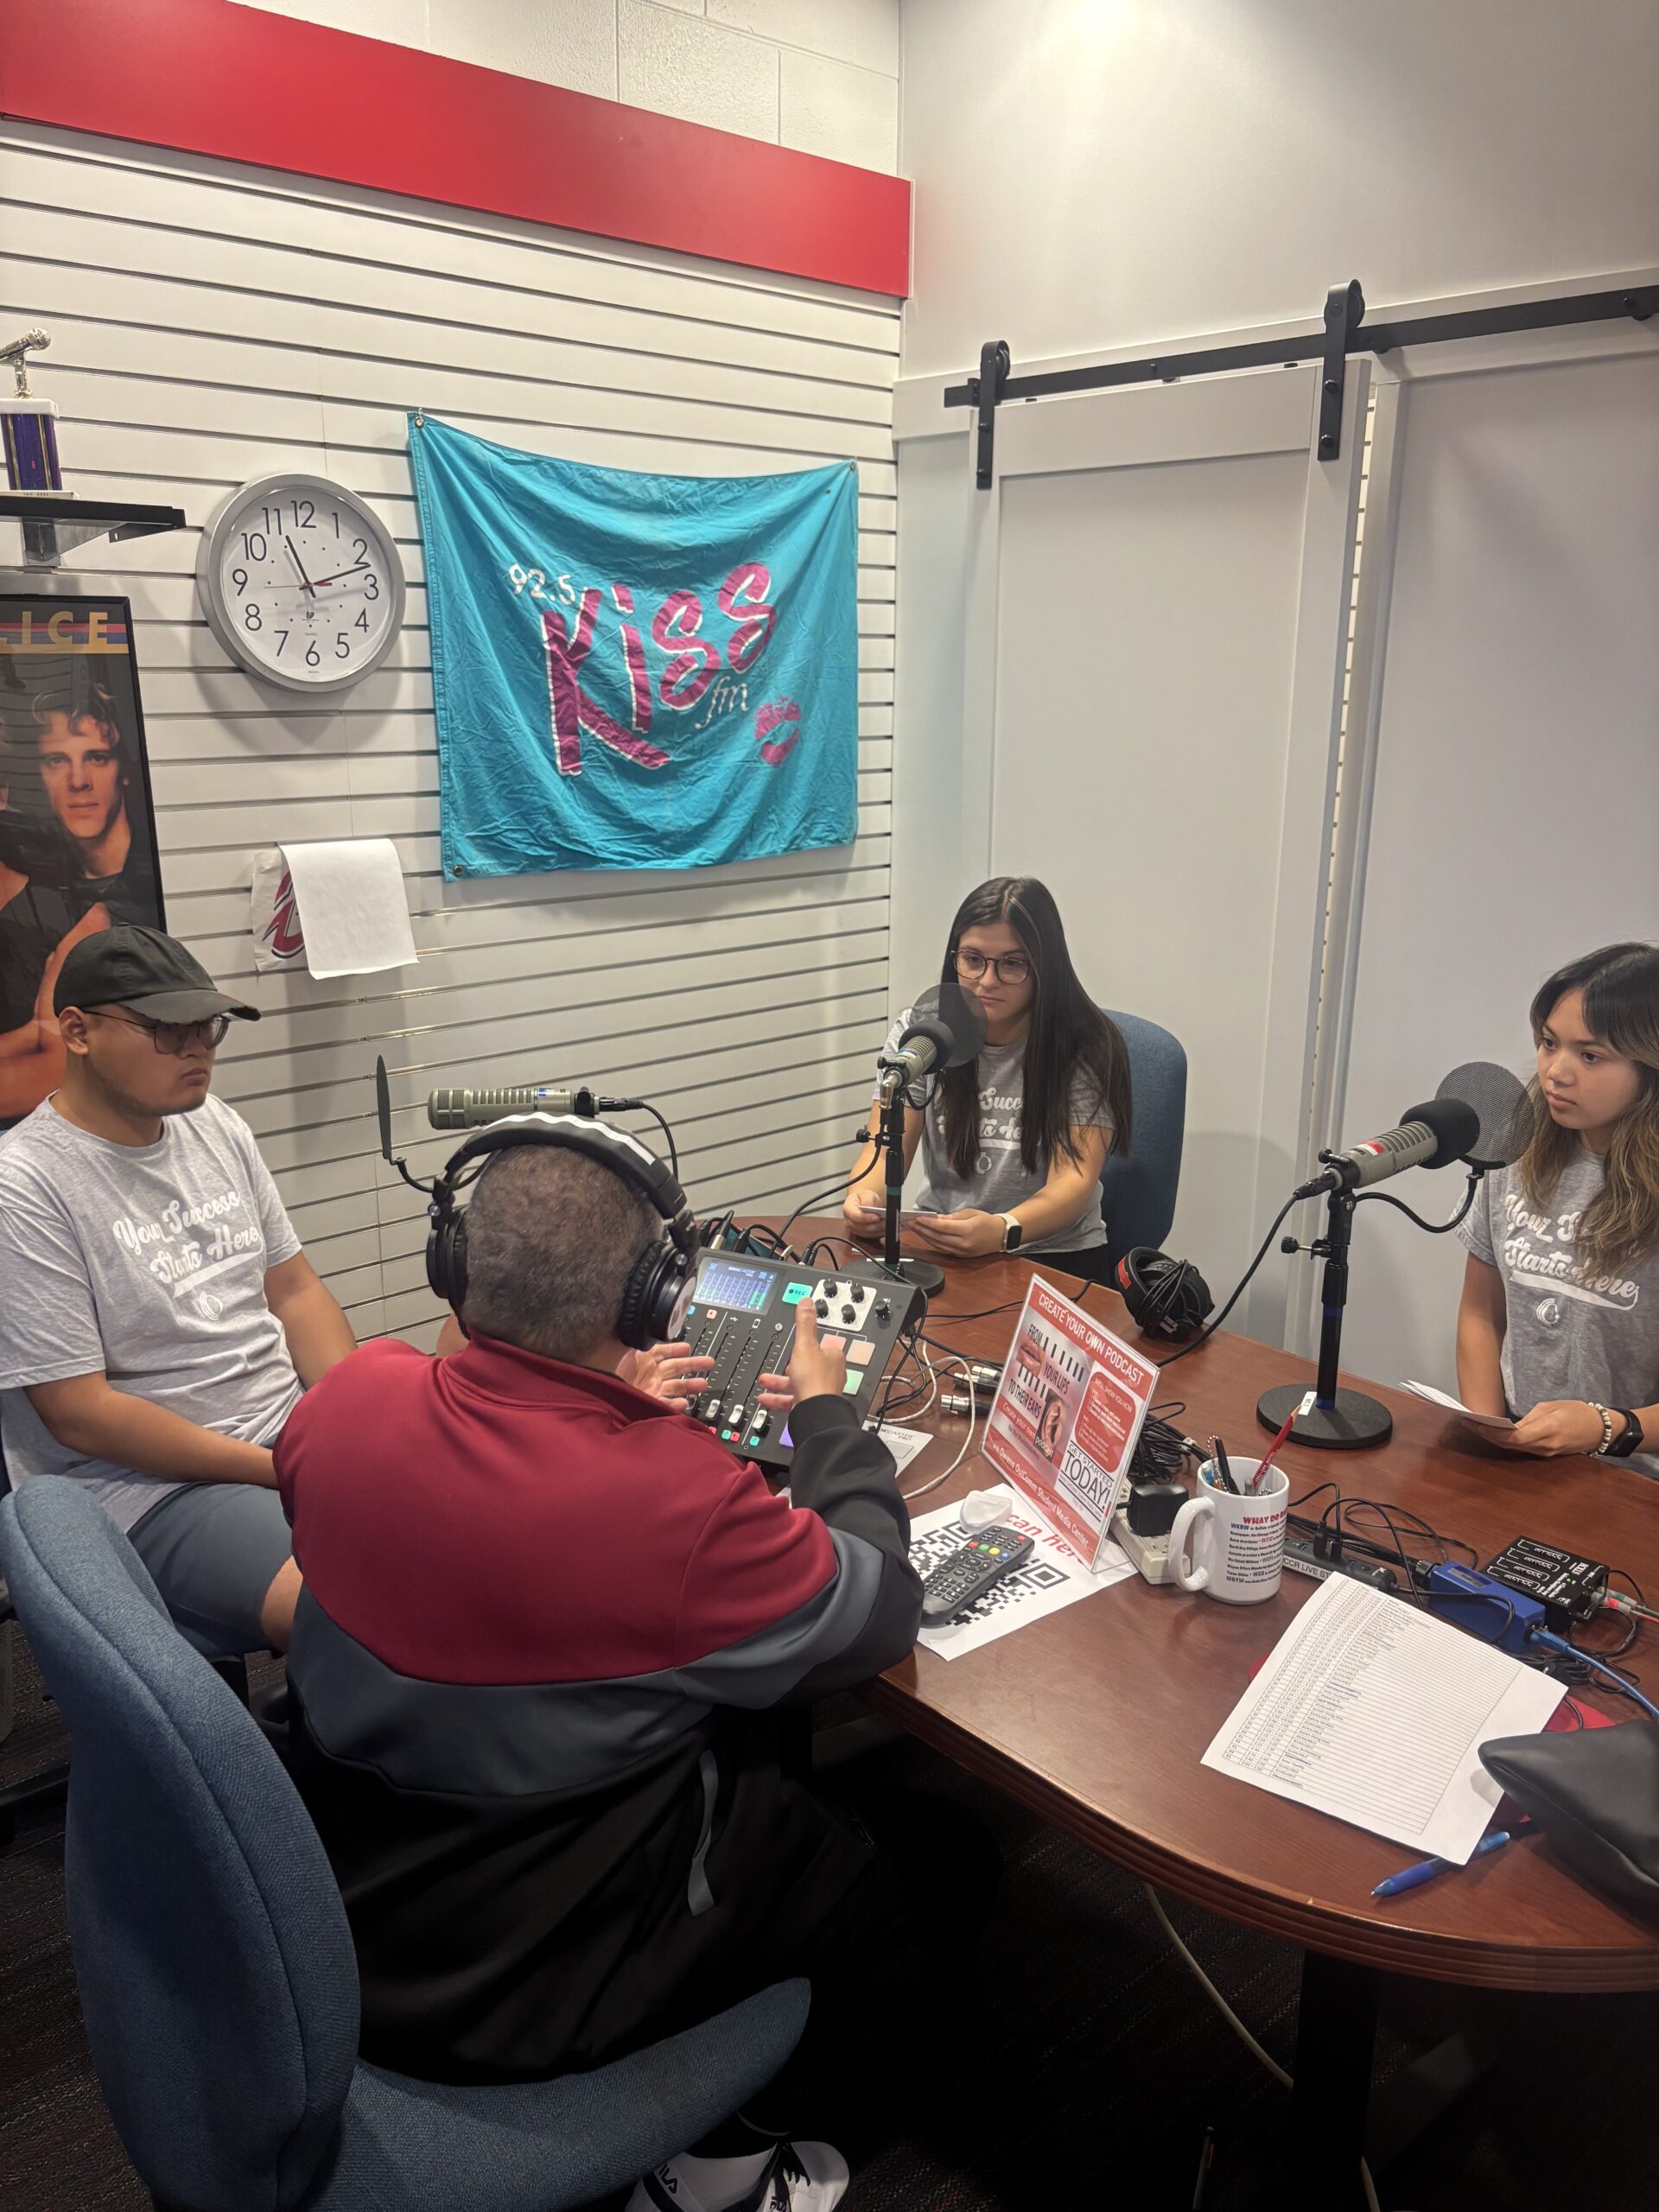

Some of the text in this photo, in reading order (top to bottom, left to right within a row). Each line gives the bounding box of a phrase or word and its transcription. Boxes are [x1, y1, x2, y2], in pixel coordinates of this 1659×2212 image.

[262, 507, 282, 535] 11
[291, 500, 316, 528] 12
[332, 512, 340, 538] 1
[241, 533, 267, 561] 10
[353, 538, 370, 565] 2
[232, 569, 248, 596] 9
[364, 574, 378, 600] 3
[508, 563, 576, 607] 92.5
[0, 611, 109, 645] ICE
[245, 604, 262, 631] 8
[354, 607, 370, 632] 4
[274, 631, 289, 657] 7
[305, 640, 320, 666] 6
[335, 632, 350, 658] 5
[540, 562, 777, 776] Kiss
[112, 1191, 241, 1255] Your Success
[1504, 1194, 1554, 1243] Your
[149, 1241, 203, 1284] Starts
[1504, 1236, 1573, 1279] Starts
[1027, 1323, 1043, 1346] FROM
[1038, 1293, 1144, 1386] CREATE YOUR OWN PODCAST
[1042, 1362, 1070, 1396] YOUR LIPS
[1007, 1378, 1041, 1420] TO THEIR EARS
[1002, 1401, 1017, 1420] Create
[1015, 1415, 1027, 1432] your
[1026, 1425, 1036, 1439] own
[1034, 1433, 1054, 1460] podcast
[1061, 1449, 1110, 1510] TODAY!
[1068, 1442, 1082, 1459] GET
[1082, 1455, 1113, 1489] STARTED
[998, 1447, 1015, 1470] Owens
[1036, 1486, 1057, 1514] Student
[1055, 1507, 1072, 1530] Media
[1070, 1523, 1089, 1548] Center
[1243, 1516, 1269, 1524] WHAT
[1270, 1513, 1279, 1522] DO
[1301, 1564, 1319, 1576] LIVE
